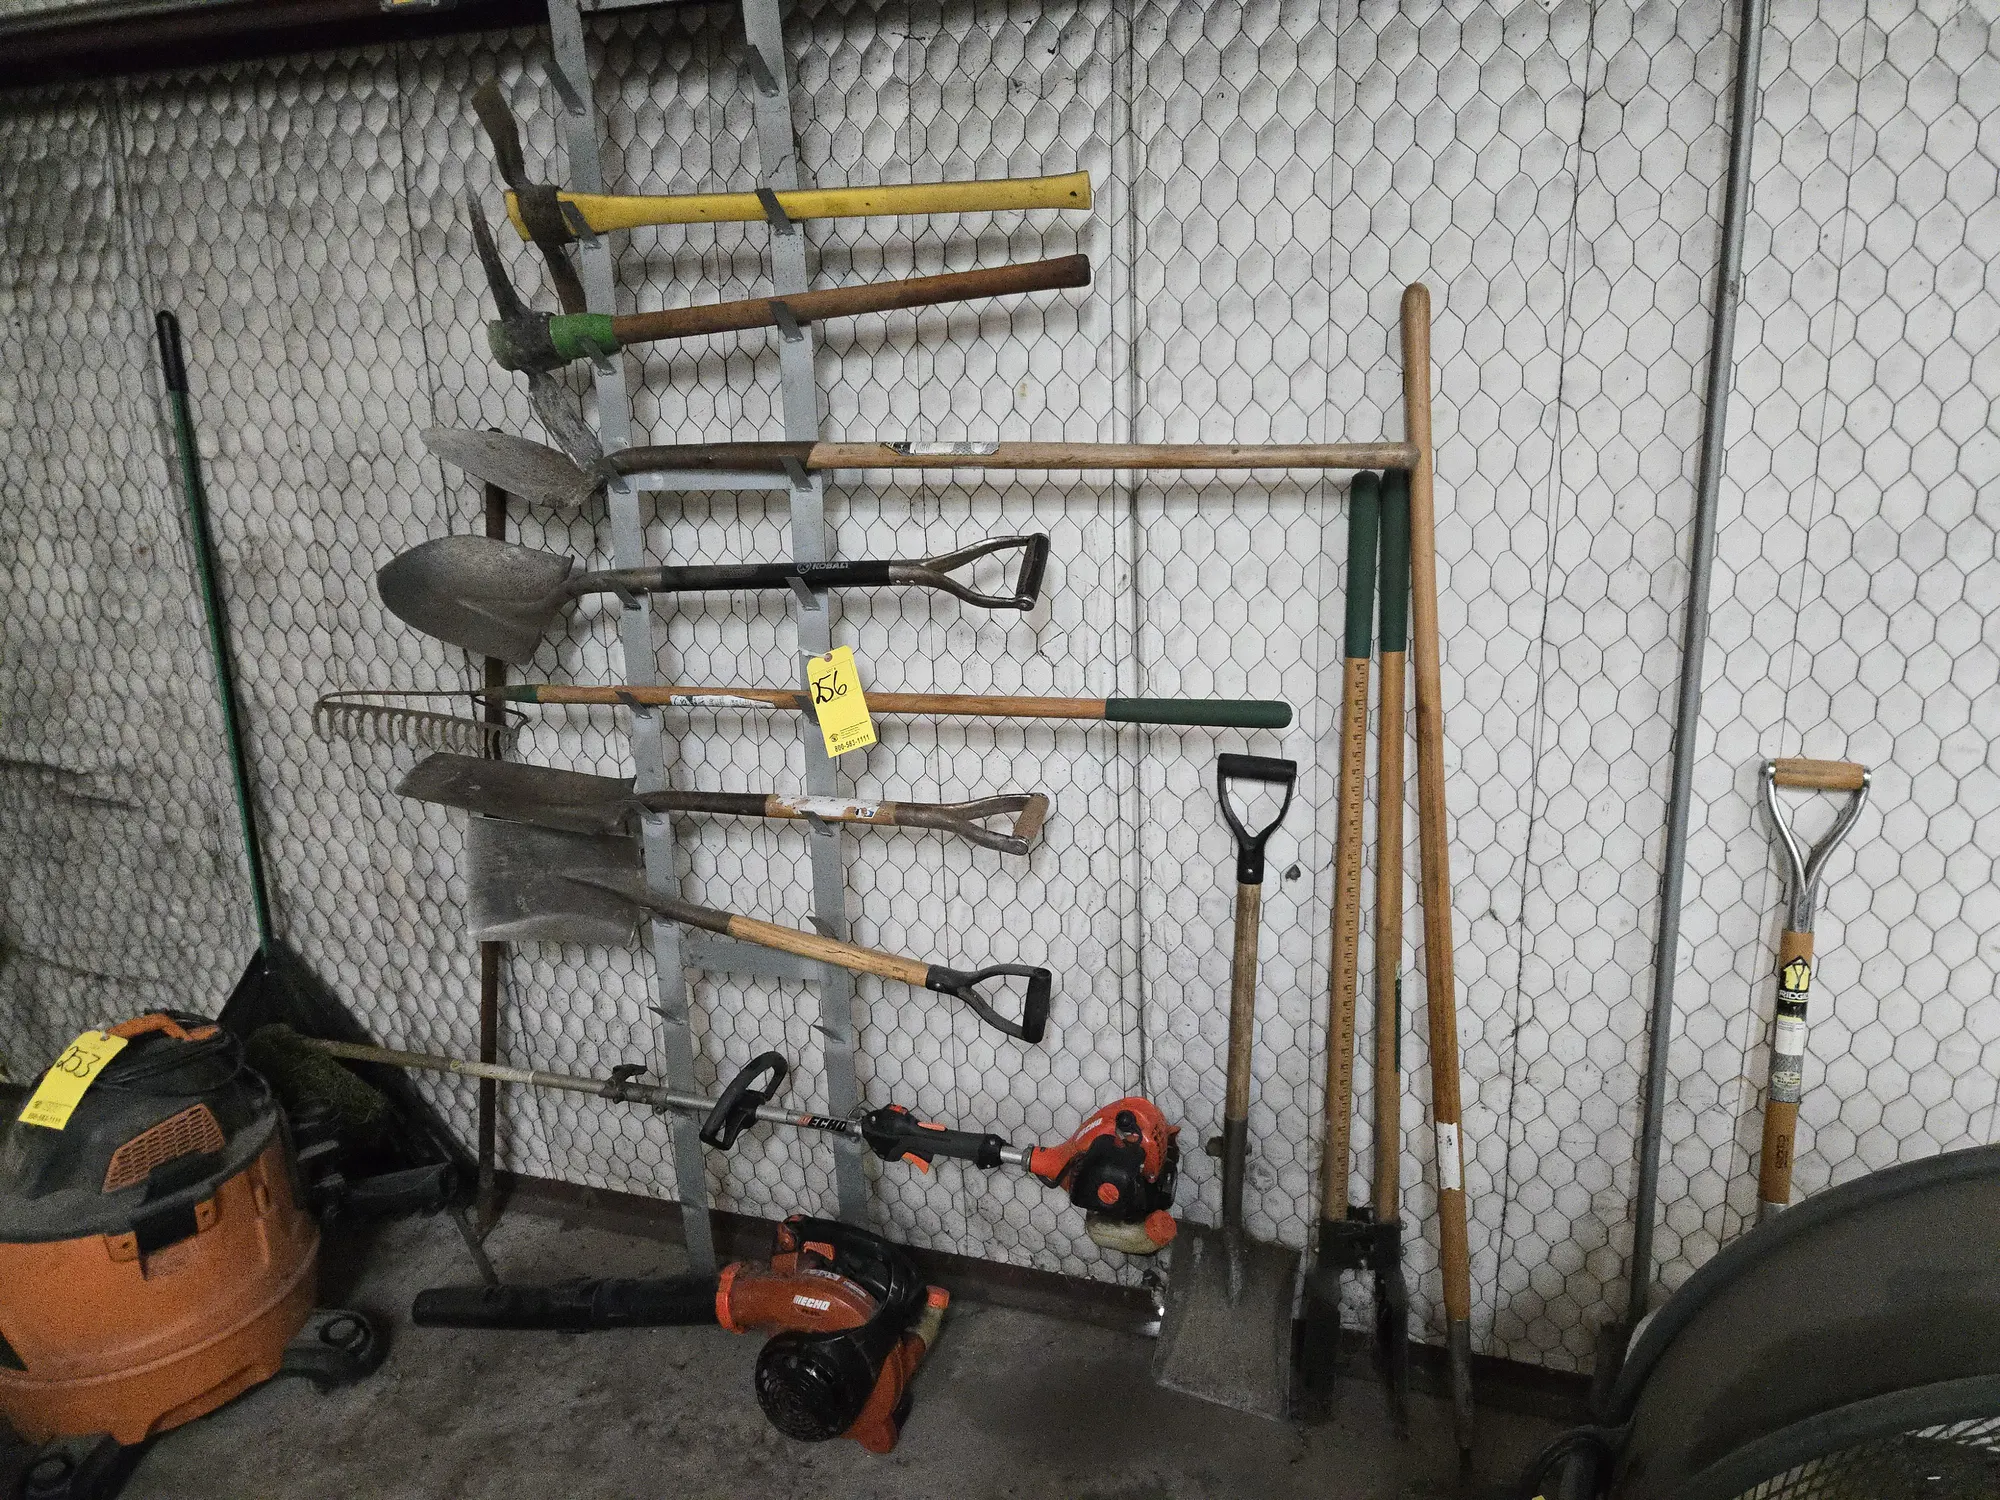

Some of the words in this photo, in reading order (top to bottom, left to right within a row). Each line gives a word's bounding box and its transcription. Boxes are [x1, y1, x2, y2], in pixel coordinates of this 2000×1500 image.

[812, 562, 849, 570] KOBALT
[812, 670, 848, 704] 256
[834, 734, 870, 753] 800-583-1111
[56, 1046, 101, 1078] 253
[808, 1115, 848, 1132] ECHO
[801, 1297, 831, 1311] ECHO
